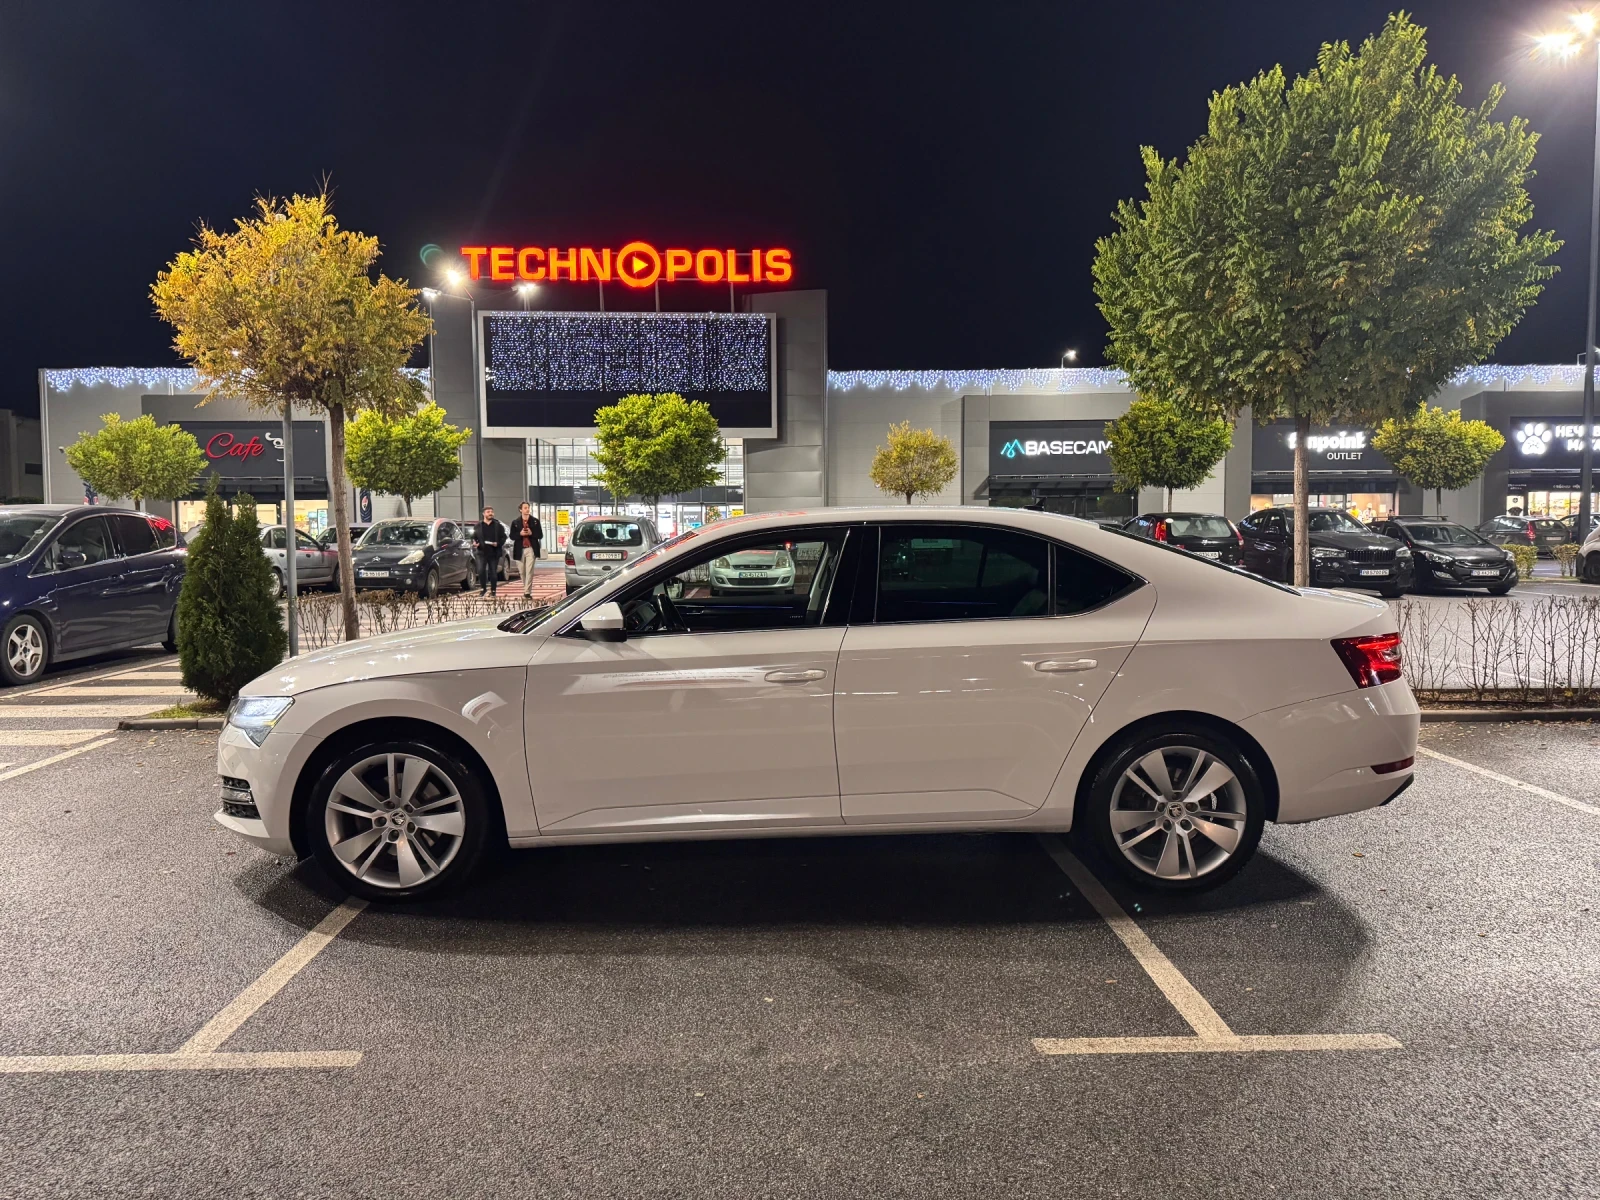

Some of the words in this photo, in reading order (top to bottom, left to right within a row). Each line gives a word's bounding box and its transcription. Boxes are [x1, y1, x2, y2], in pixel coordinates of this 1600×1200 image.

[461, 242, 792, 288] TECHNOPOLIS
[206, 432, 264, 462] Cafe
[1326, 452, 1363, 460] OUTLET
